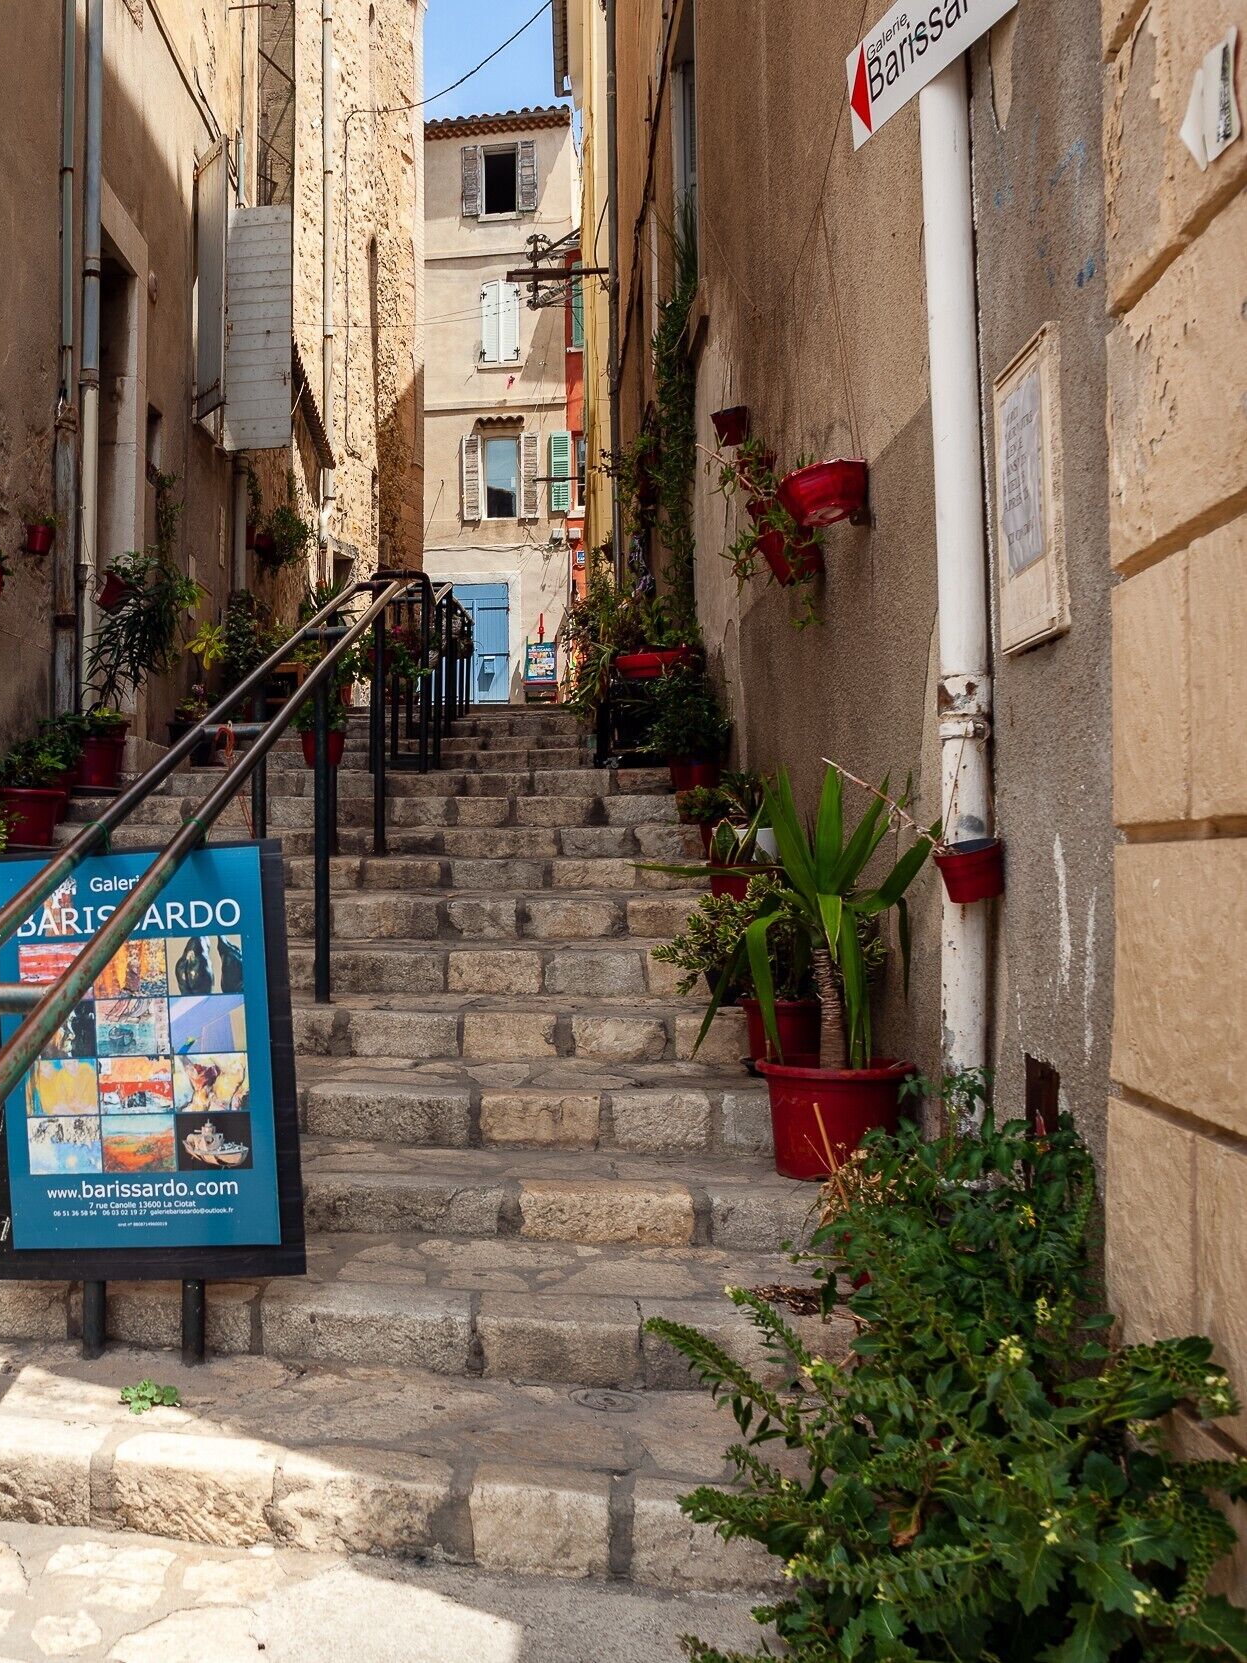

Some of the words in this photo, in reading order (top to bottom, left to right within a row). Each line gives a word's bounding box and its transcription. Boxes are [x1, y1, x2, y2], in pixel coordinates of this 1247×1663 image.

[866, 13, 908, 61] Galerie
[90, 875, 140, 892] Galer
[17, 898, 241, 937] BARISARDO
[47, 1178, 239, 1199] www.barissardo.com
[138, 1201, 162, 1209] 13600
[174, 1200, 197, 1208] Ciotat
[149, 1207, 234, 1216] galeriebarissardo@outlook.fr
